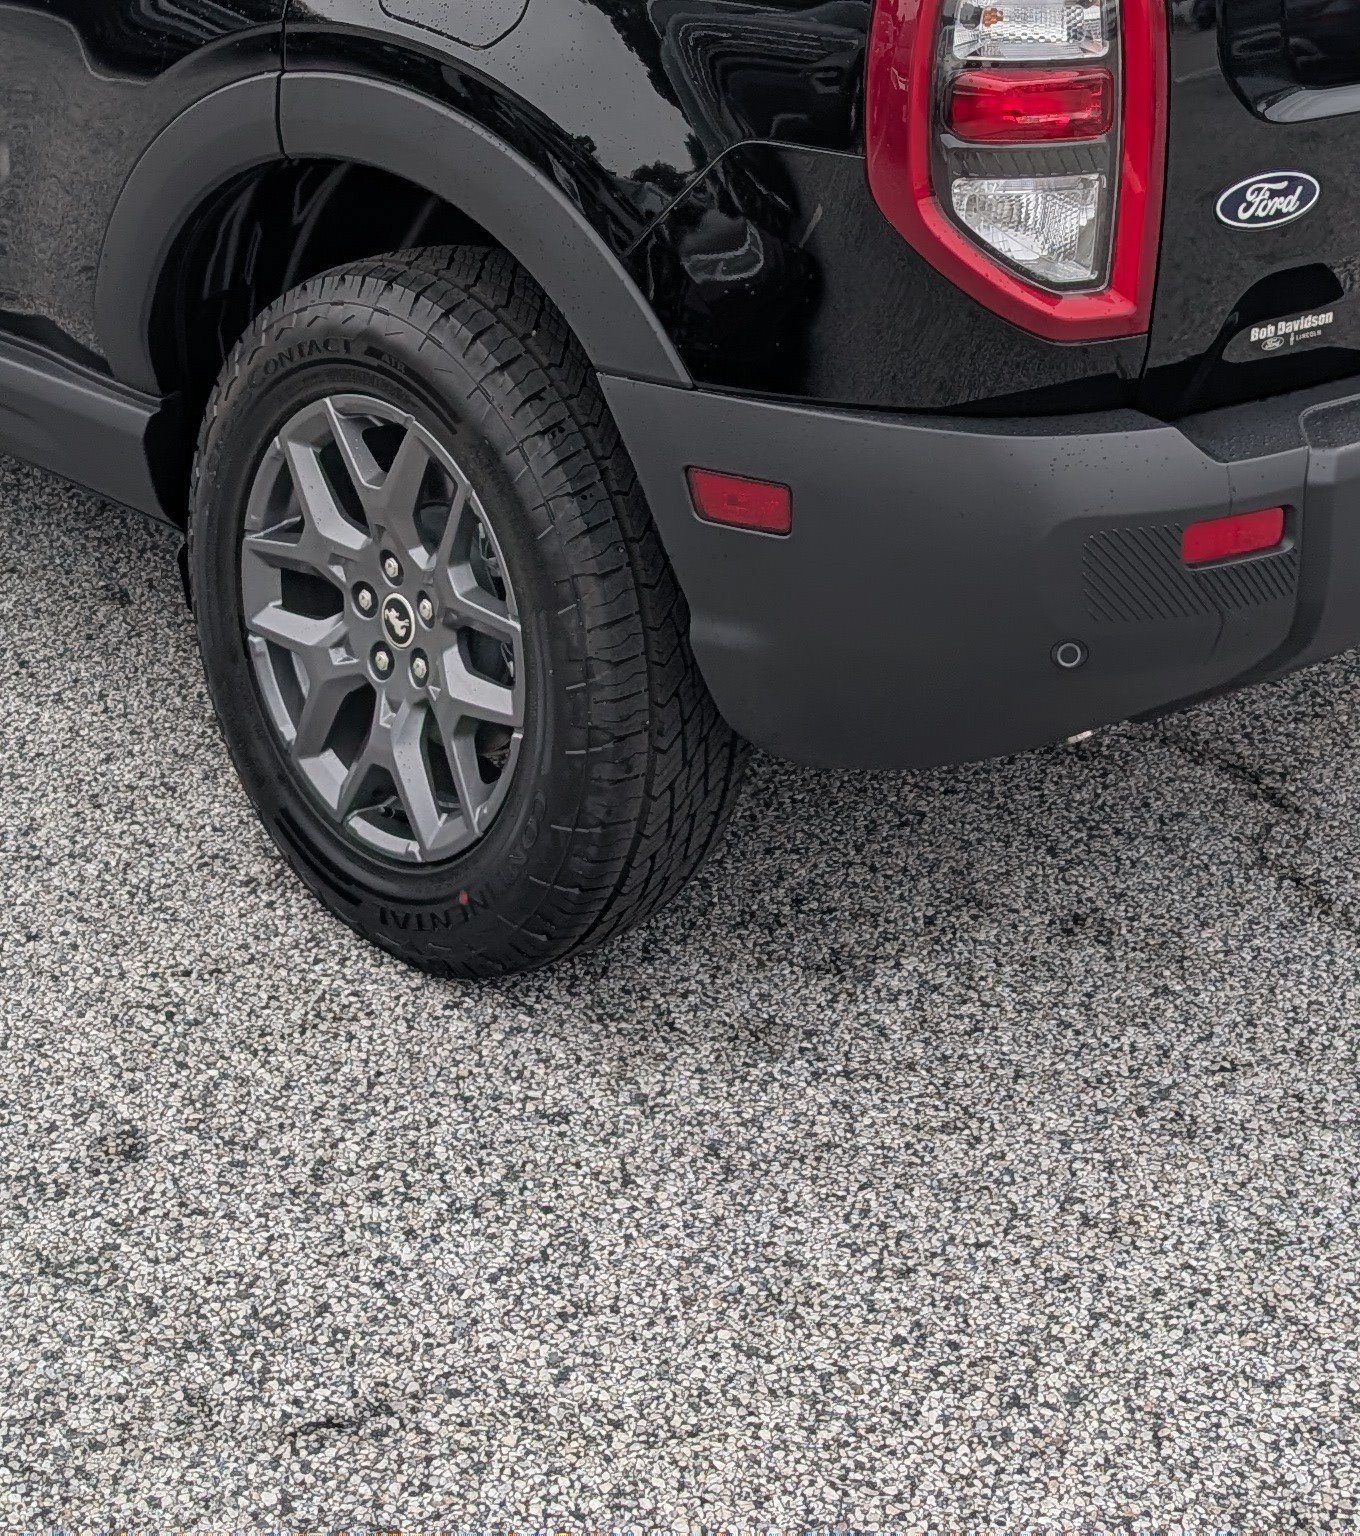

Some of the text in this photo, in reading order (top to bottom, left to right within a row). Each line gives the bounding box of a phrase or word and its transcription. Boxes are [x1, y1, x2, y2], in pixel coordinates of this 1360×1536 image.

[1237, 180, 1304, 220] Ford
[1250, 311, 1334, 342] Bob Davidson
